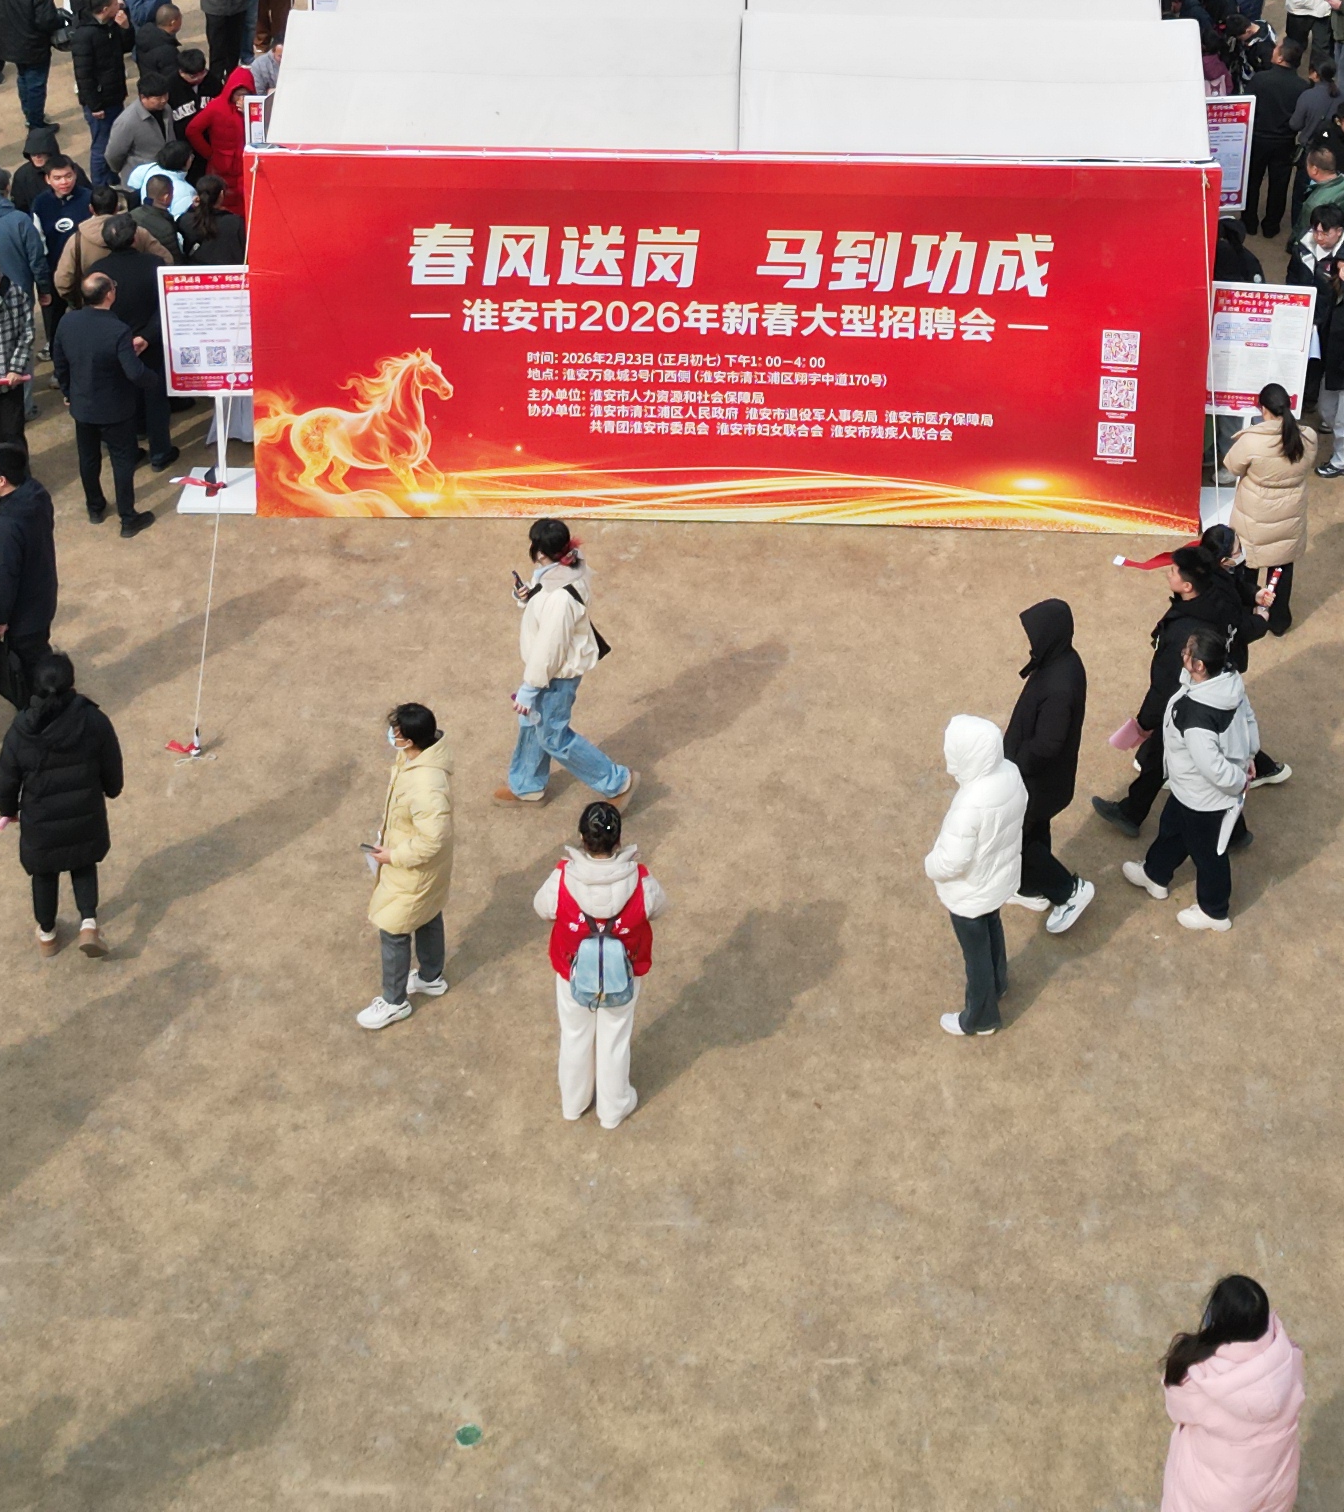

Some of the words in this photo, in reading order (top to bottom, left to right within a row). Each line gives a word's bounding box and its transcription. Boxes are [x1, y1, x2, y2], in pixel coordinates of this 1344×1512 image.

[407, 223, 701, 289] 春风送岗
[755, 229, 1056, 298] 马到功成
[462, 299, 996, 342] 淮安市2026年新春大型招聘会
[589, 420, 711, 438] 共青团淮安市委员会
[715, 422, 825, 440] 淮安市妇女联合会
[829, 424, 954, 443] 淮安市残疾人联合会
[744, 407, 879, 425] 淮安市退役军人事务局
[884, 410, 994, 429] 淮安市医疗保障局
